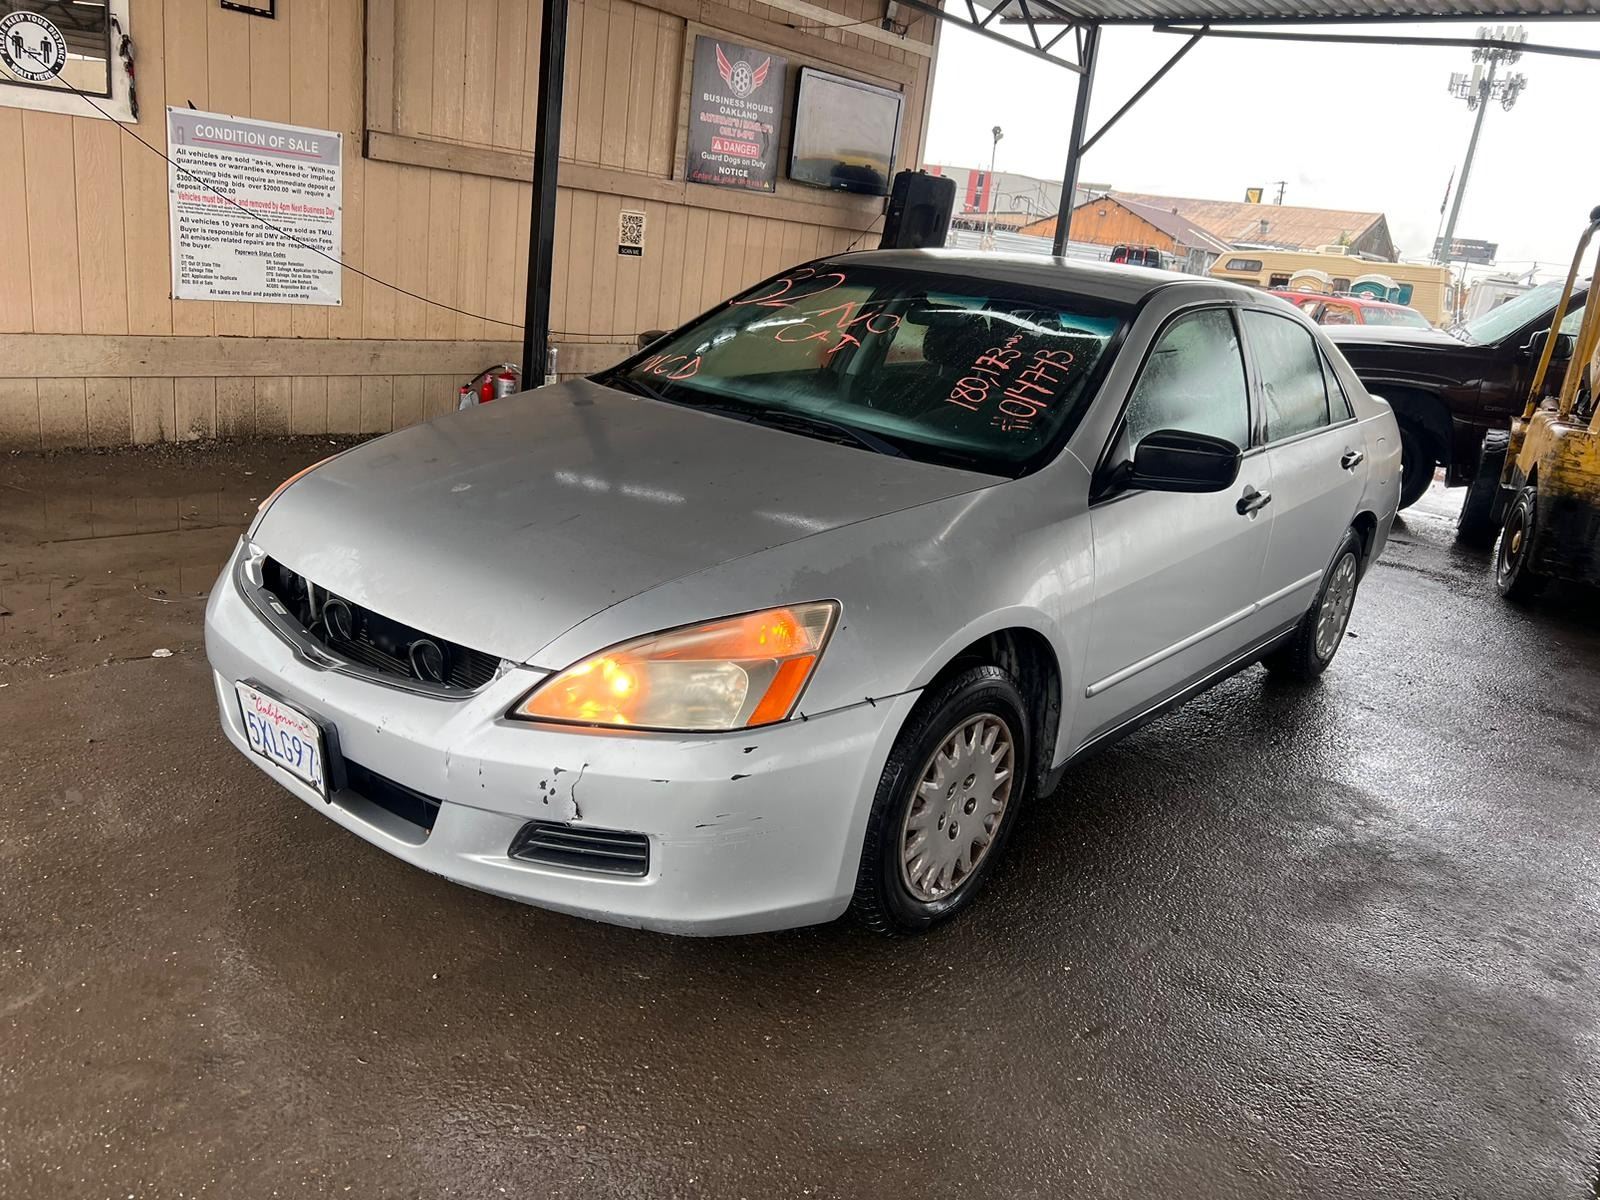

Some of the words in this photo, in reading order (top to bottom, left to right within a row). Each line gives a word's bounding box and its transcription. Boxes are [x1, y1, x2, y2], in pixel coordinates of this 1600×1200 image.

[5, 14, 25, 27] KEEP
[26, 14, 49, 28] YOUR
[48, 26, 65, 64] DISTANCE
[11, 63, 33, 79] WAIT
[703, 93, 745, 108] BUSINESS
[746, 102, 773, 113] HOURS
[720, 107, 758, 120] OAKLAND
[195, 124, 265, 145] CONDITION
[269, 135, 285, 148] OF
[288, 138, 319, 153] SALE
[188, 150, 219, 160] vehicles
[723, 141, 757, 155] DANGER
[176, 157, 217, 167] guarantees
[228, 164, 265, 173] warranties
[266, 168, 301, 177] expressed
[701, 151, 722, 161] Guard
[723, 155, 740, 165] Dogs
[751, 159, 766, 170] Duty
[191, 169, 216, 178] winning
[276, 179, 306, 188] immediate
[307, 182, 328, 191] deposit
[718, 166, 749, 177] NOTICE
[176, 182, 201, 190] deposit
[203, 177, 229, 187] Winning
[263, 184, 289, 192] $2000.00
[304, 189, 324, 197] require
[177, 191, 201, 201] Vehicles
[202, 194, 215, 203] must
[217, 196, 223, 204] be
[249, 200, 272, 209] removed
[272, 201, 279, 211] by
[279, 202, 290, 212] 4pm
[291, 203, 303, 212] Next
[303, 204, 325, 215] Business
[325, 206, 335, 217] Day
[180, 226, 199, 234] Buyer
[207, 229, 244, 237] responsible
[191, 218, 220, 226] vehicles
[294, 226, 308, 234] sold
[234, 248, 257, 256] Paperwork
[288, 242, 325, 251] respoibility
[256, 697, 304, 731] California
[247, 710, 322, 785] 5XLG97
